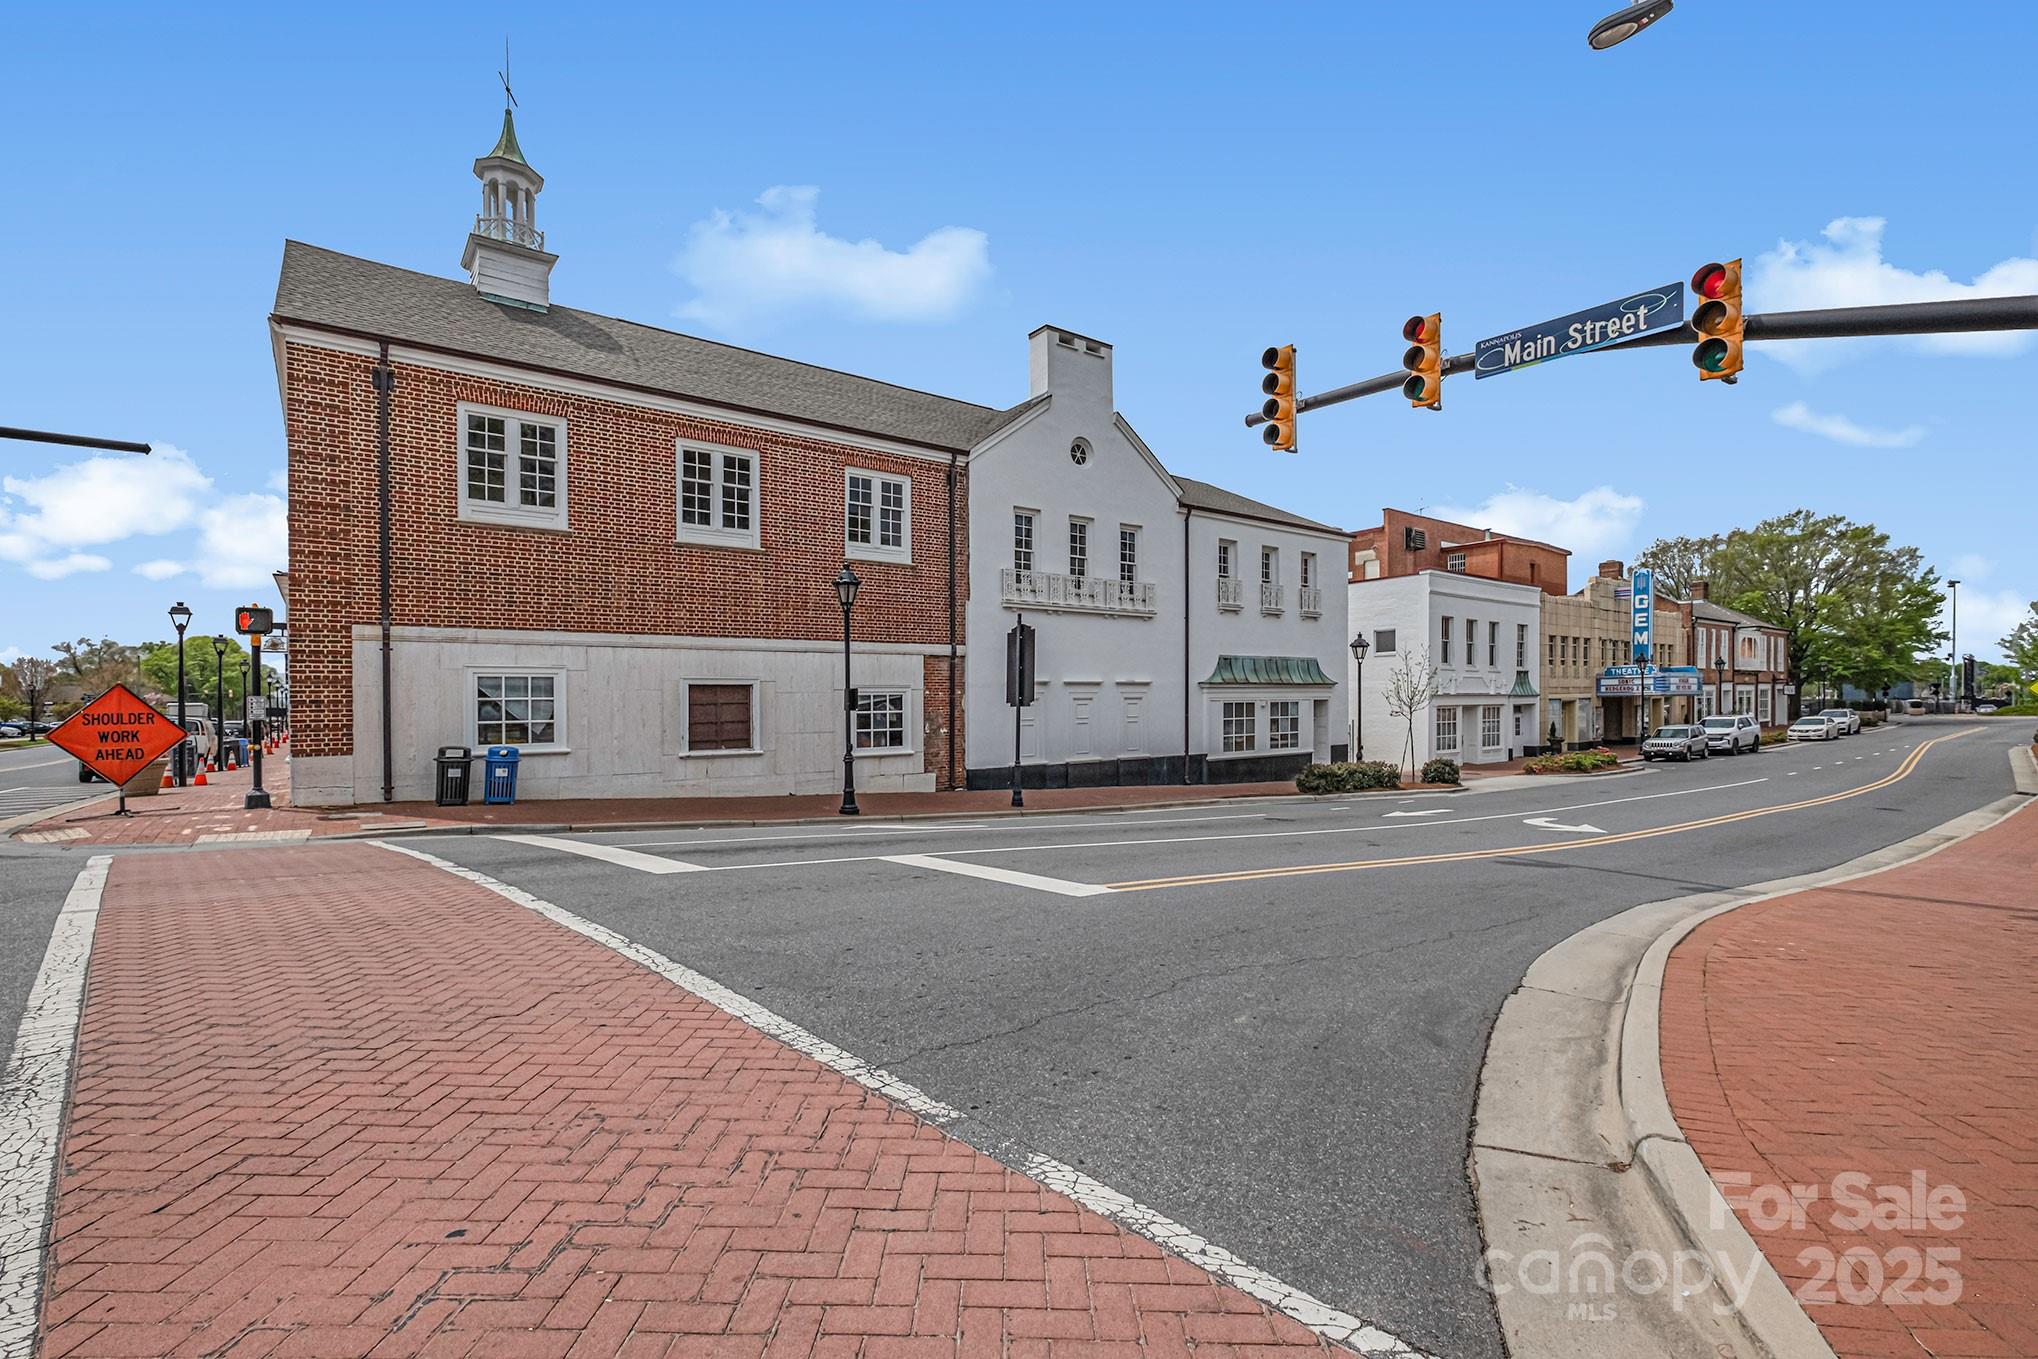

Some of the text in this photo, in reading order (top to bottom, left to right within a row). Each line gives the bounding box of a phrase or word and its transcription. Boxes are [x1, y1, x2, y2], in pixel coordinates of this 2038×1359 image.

[1503, 305, 1648, 368] Main Street
[1634, 594, 1649, 645] GEM
[81, 712, 155, 726] SHOULDER
[98, 731, 140, 743] WORK
[95, 748, 145, 761] AHEAD
